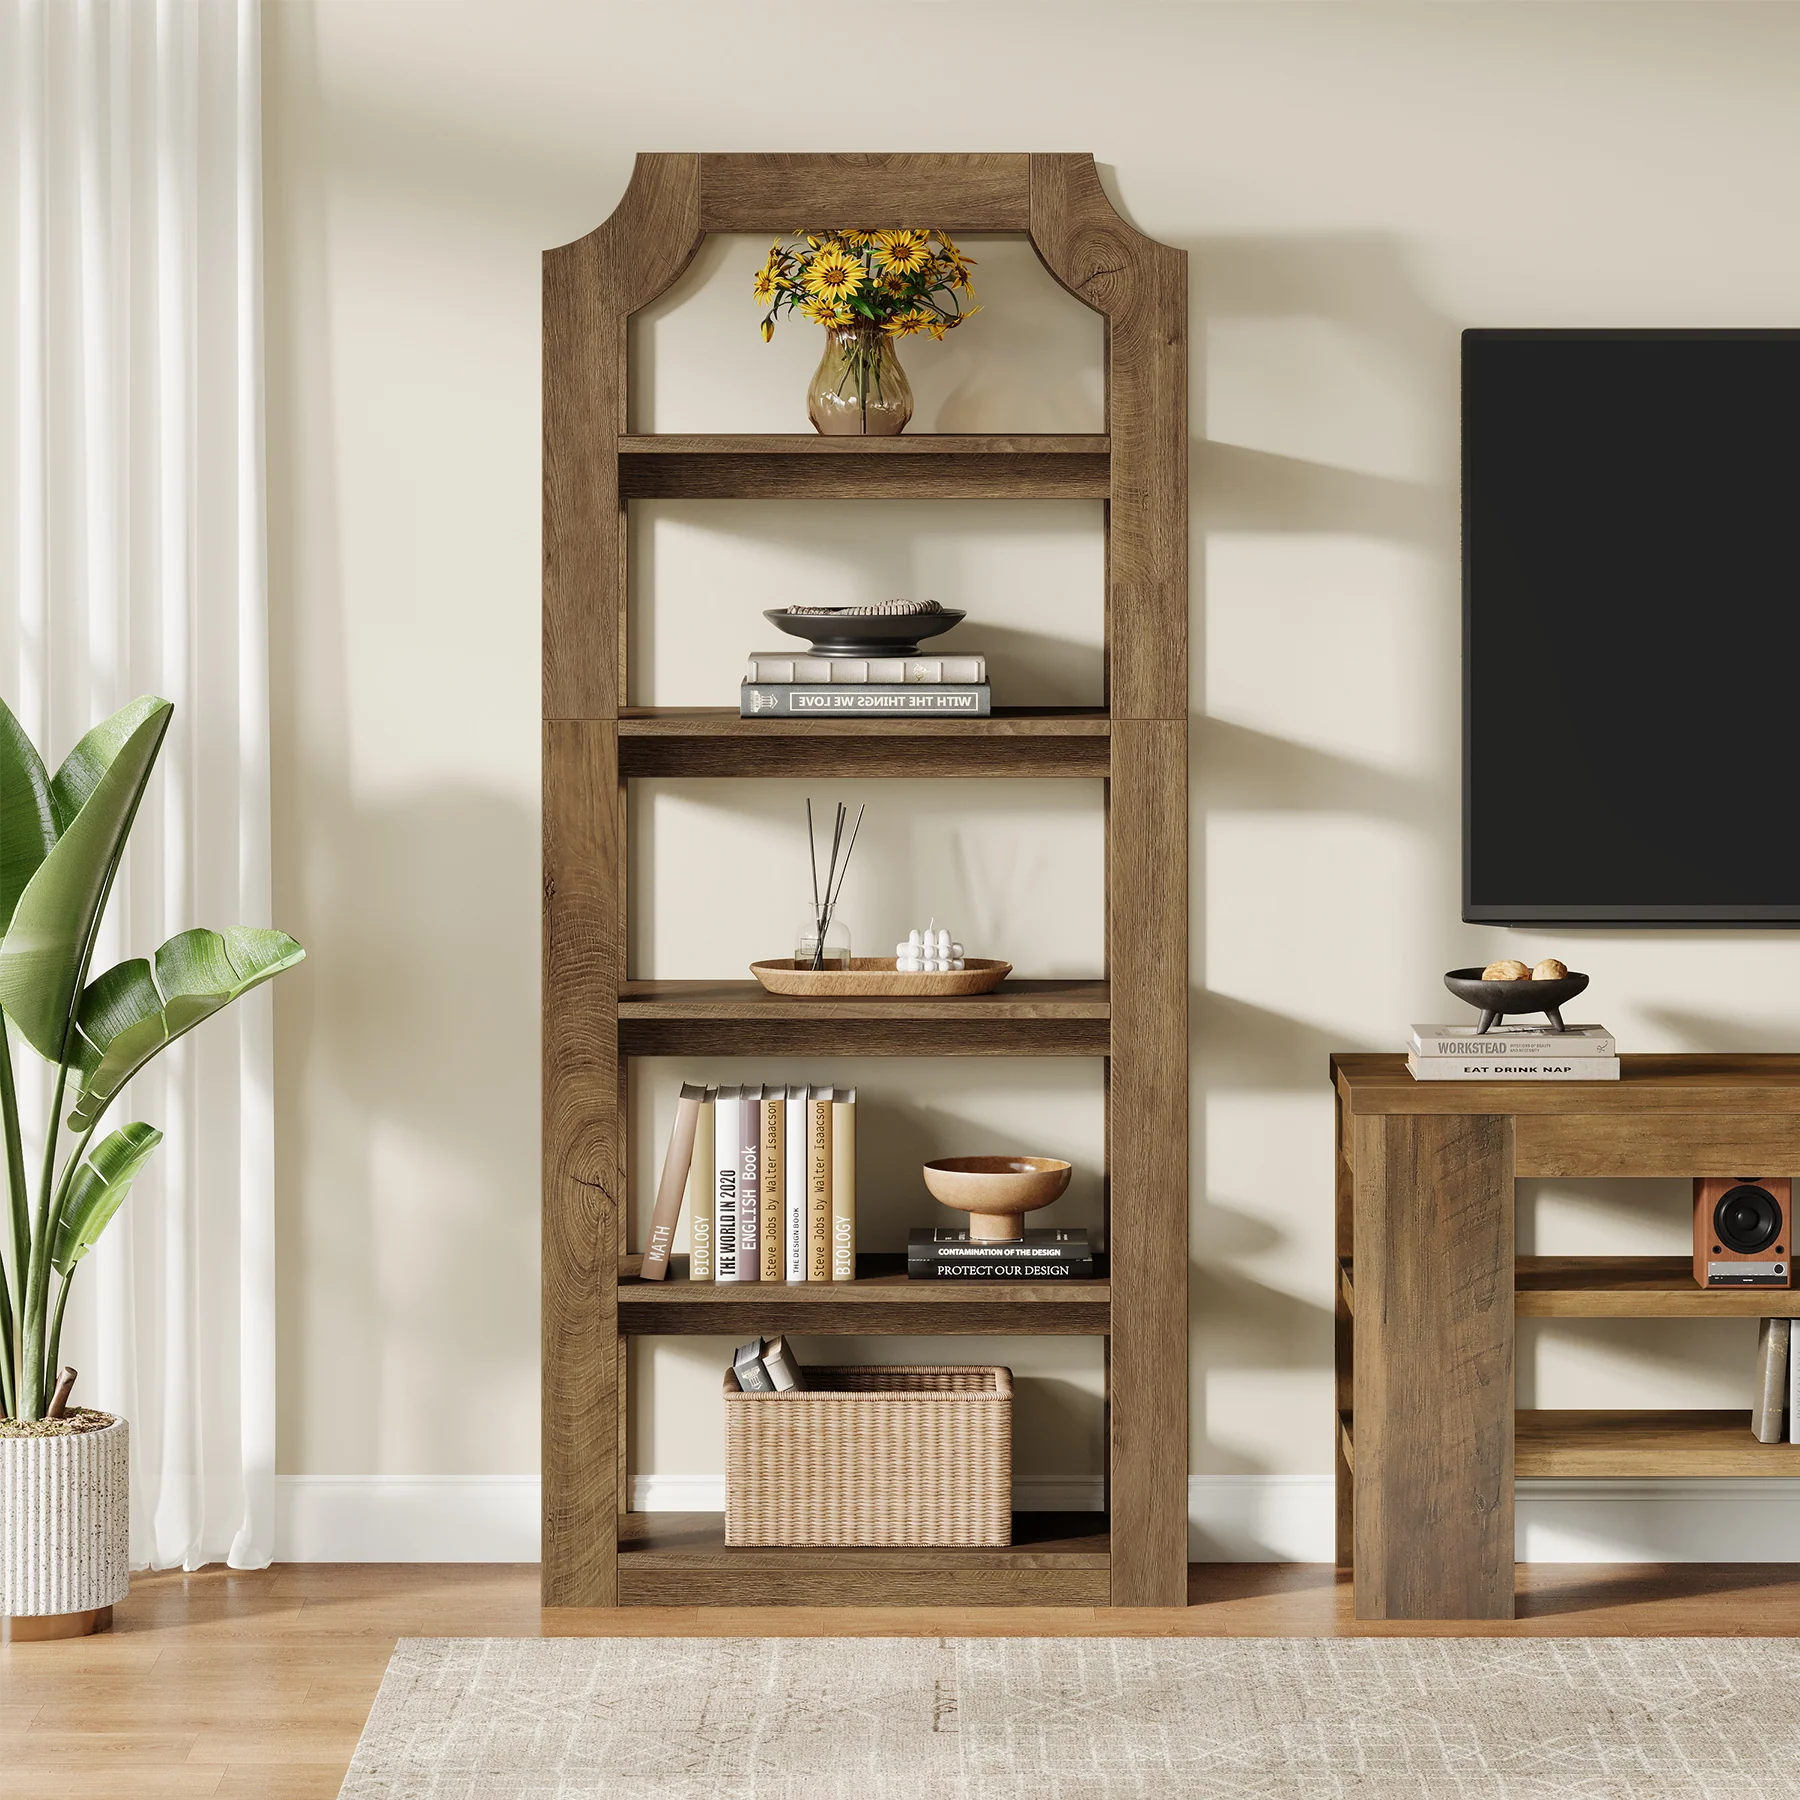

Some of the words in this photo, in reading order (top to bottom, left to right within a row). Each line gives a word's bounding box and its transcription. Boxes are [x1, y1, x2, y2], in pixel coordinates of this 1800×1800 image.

[1438, 1042, 1507, 1054] WORKSTEAD
[766, 1101, 777, 1150] Isaacson
[814, 1101, 825, 1150] Isaacson
[741, 1145, 757, 1180] Book
[765, 1156, 777, 1193] Walter
[813, 1156, 825, 1193] Walter
[720, 1169, 736, 1198] 2020
[720, 1201, 736, 1212] IN
[741, 1189, 756, 1250] ENGLISH
[765, 1199, 779, 1211] by
[813, 1199, 827, 1211] by
[648, 1225, 671, 1262] MATH
[720, 1215, 736, 1253] WORLD
[765, 1216, 777, 1240] Jobs
[813, 1216, 825, 1240] Jobs
[694, 1215, 709, 1275] BIOLOGY
[835, 1215, 851, 1275] BIOLOGY
[938, 1248, 1003, 1256] CONTAMINATION
[1003, 1248, 1015, 1256] OF
[1015, 1248, 1031, 1256] THE
[1032, 1248, 1061, 1256] DESIGN
[720, 1256, 736, 1276] THE
[766, 1246, 777, 1277] Steve
[814, 1246, 825, 1277] Steve
[937, 1265, 993, 1276] PROTECT
[994, 1265, 1023, 1276] OUR
[1024, 1265, 1069, 1276] DESIGN
